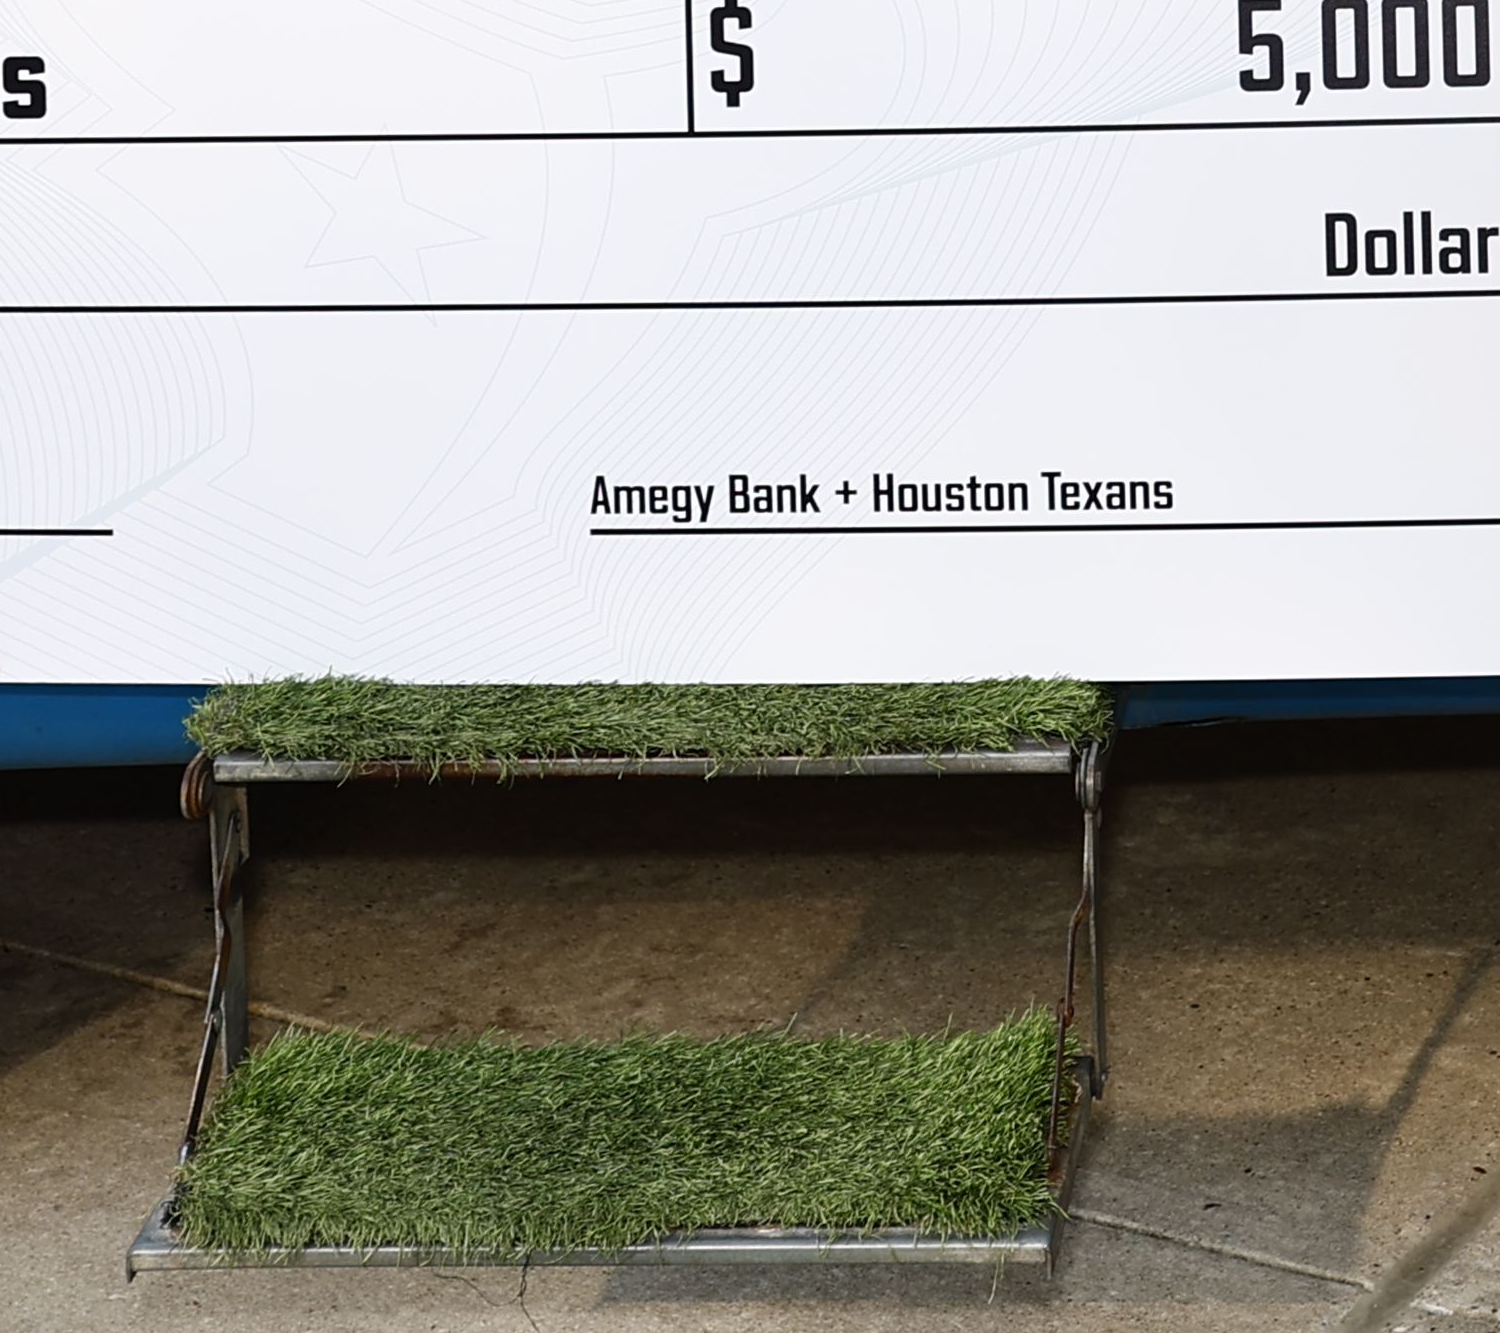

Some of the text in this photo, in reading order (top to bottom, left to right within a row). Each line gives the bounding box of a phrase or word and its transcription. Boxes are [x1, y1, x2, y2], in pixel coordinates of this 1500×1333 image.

[590, 475, 715, 521] Amegy
[728, 473, 821, 514] Bank
[872, 473, 1029, 513] Houston
[1040, 471, 1173, 511] Texans
